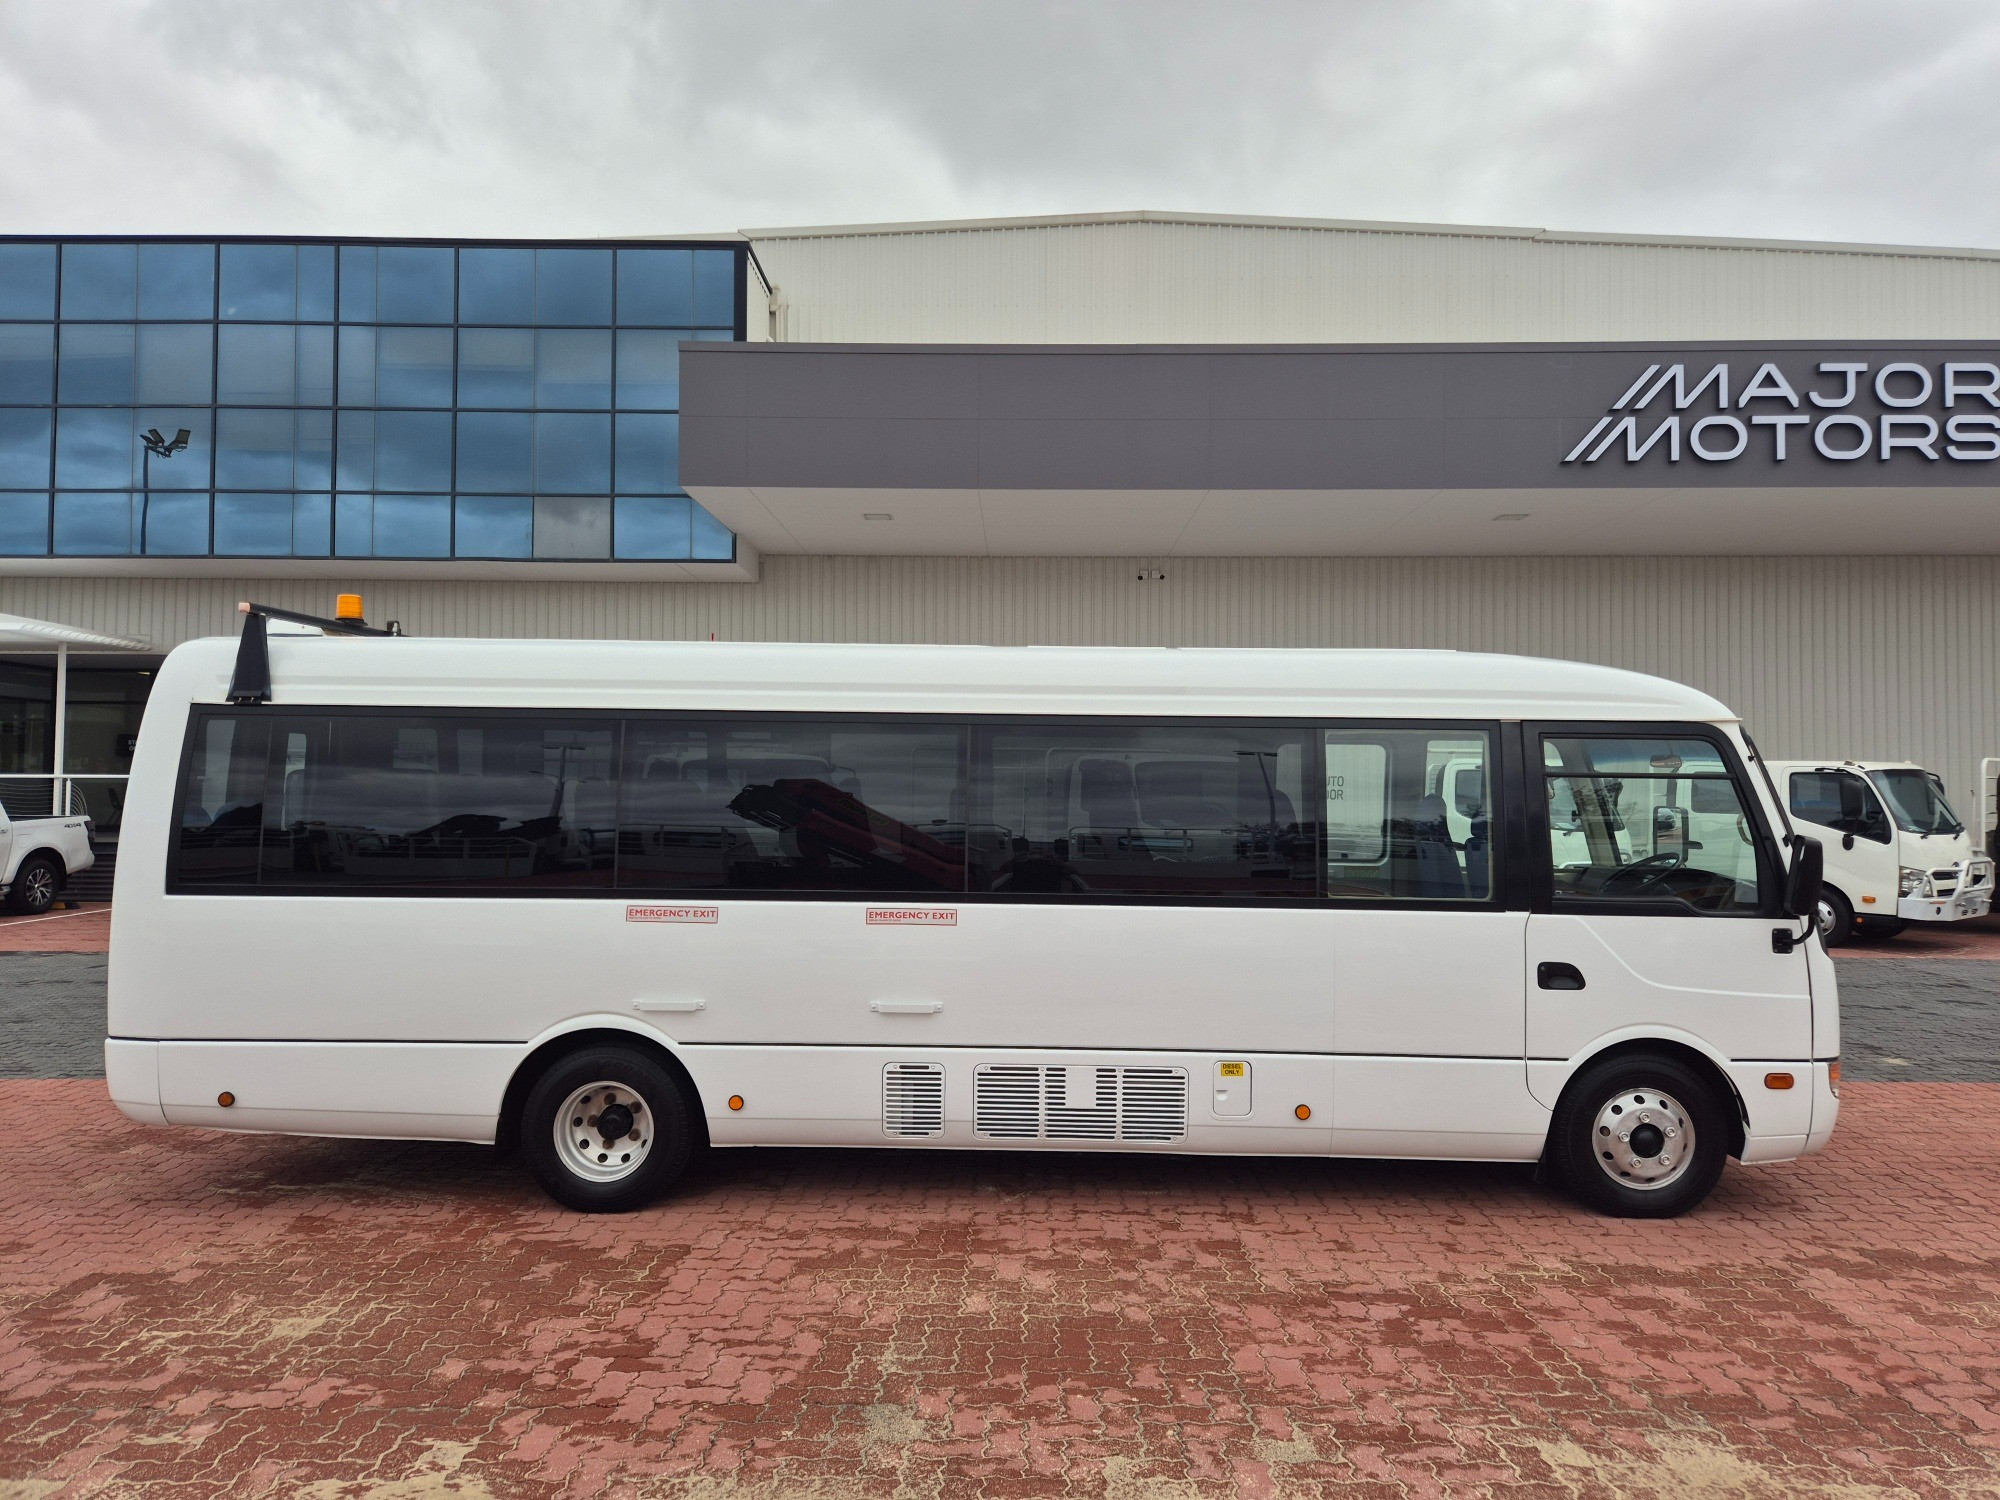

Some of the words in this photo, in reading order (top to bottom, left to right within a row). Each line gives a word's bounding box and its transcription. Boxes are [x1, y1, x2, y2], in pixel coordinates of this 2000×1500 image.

[1607, 362, 2000, 410] MAJOR
[1560, 414, 2000, 463] MOTORS
[628, 908, 691, 918] EMERGENCY
[693, 910, 717, 918] EXIT
[868, 911, 930, 920] EMERGENCY
[932, 912, 956, 920] EXIT
